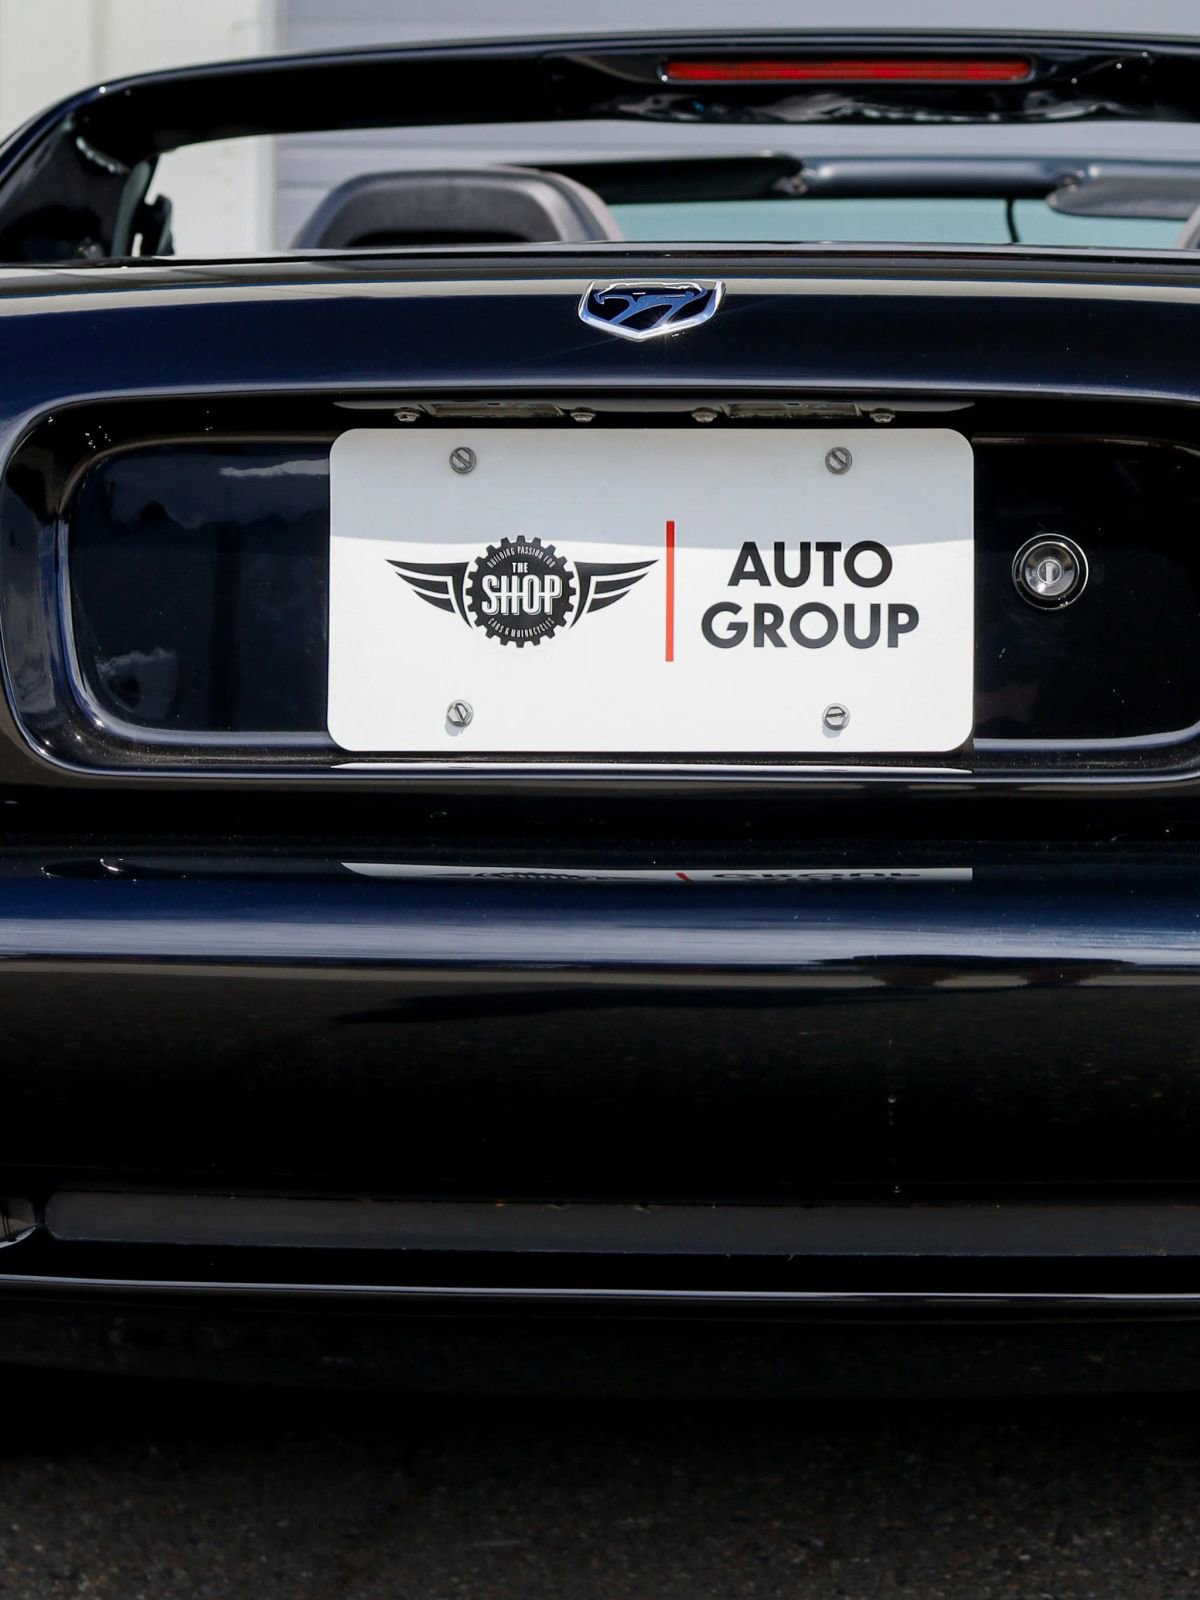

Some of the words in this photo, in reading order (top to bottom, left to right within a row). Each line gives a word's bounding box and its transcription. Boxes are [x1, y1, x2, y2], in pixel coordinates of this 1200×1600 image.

[486, 547, 515, 569] BUILDING
[517, 545, 544, 560] PASSION
[512, 562, 528, 573] THE
[728, 540, 893, 588] AUTO
[481, 574, 562, 615] SHOP
[487, 617, 504, 633] CARS
[510, 617, 555, 638] MOTORCYCLES
[701, 602, 920, 649] GROUP
